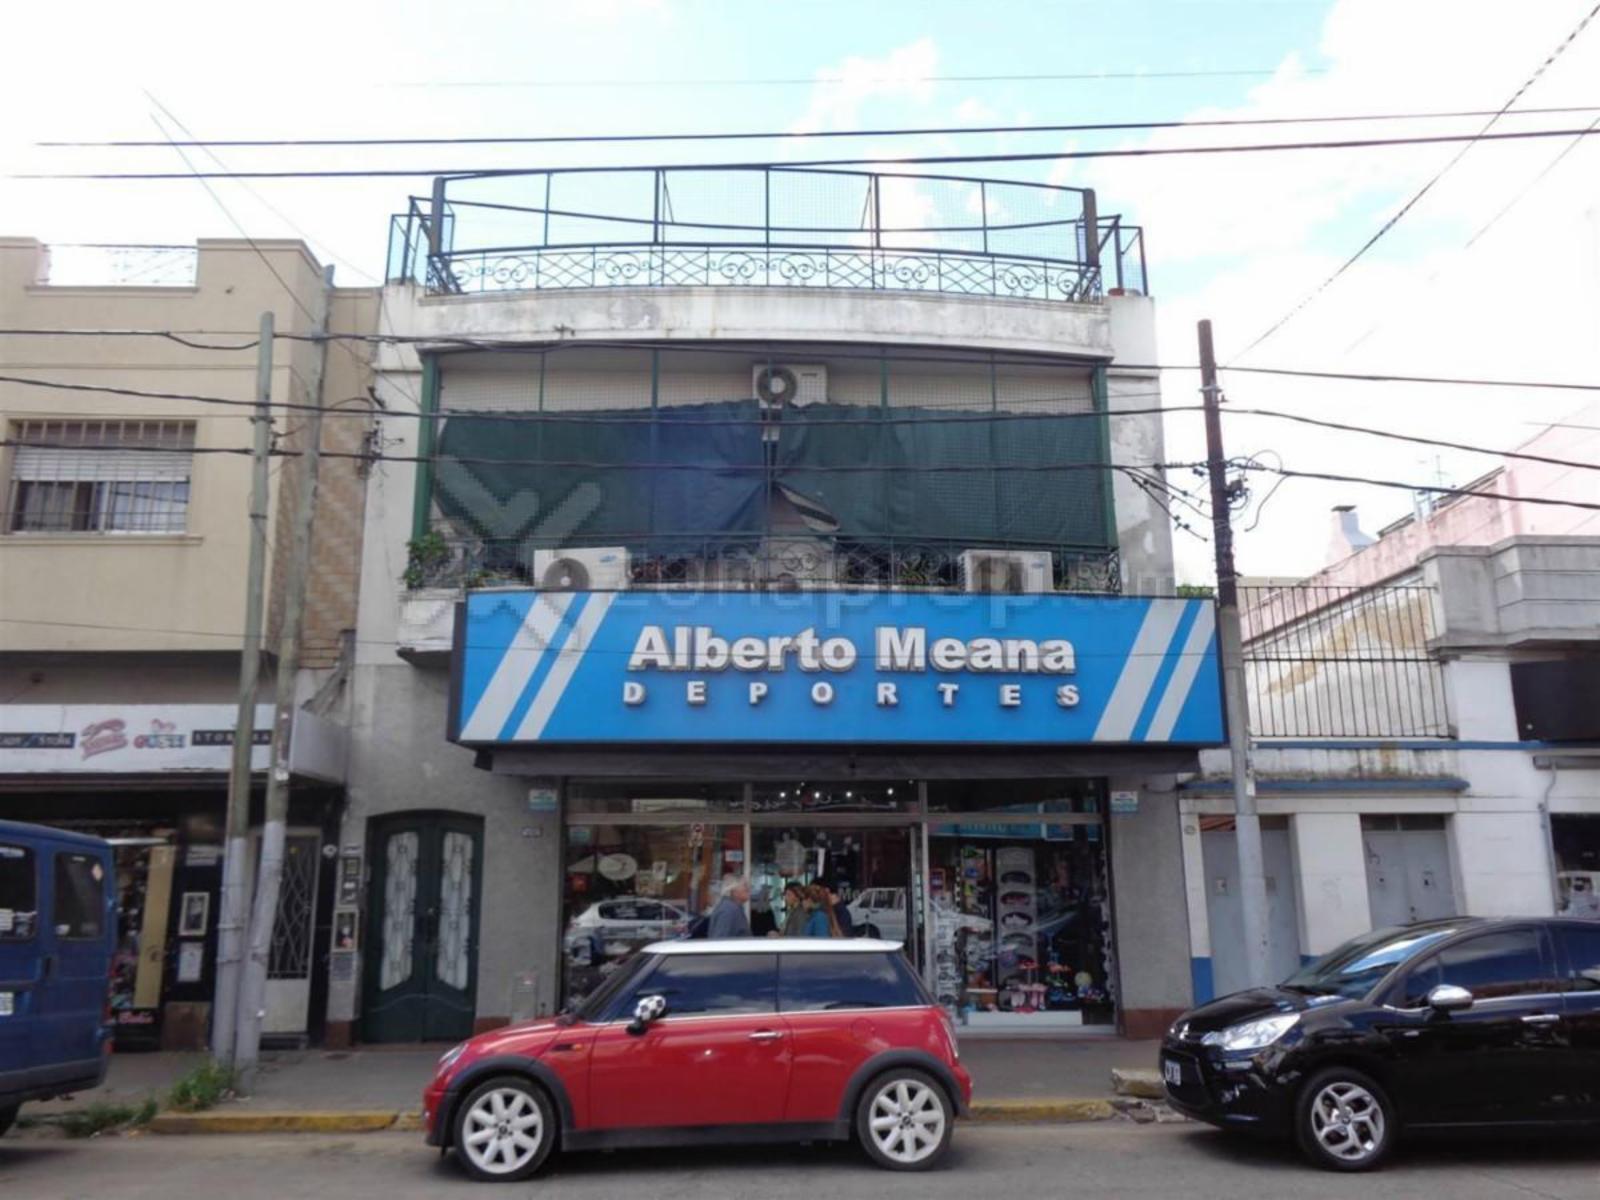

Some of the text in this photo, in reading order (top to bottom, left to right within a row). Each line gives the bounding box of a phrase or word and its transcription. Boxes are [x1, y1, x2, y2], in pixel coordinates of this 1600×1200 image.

[627, 625, 1077, 674] Alberto Meana
[622, 681, 1080, 706] DEPORTES
